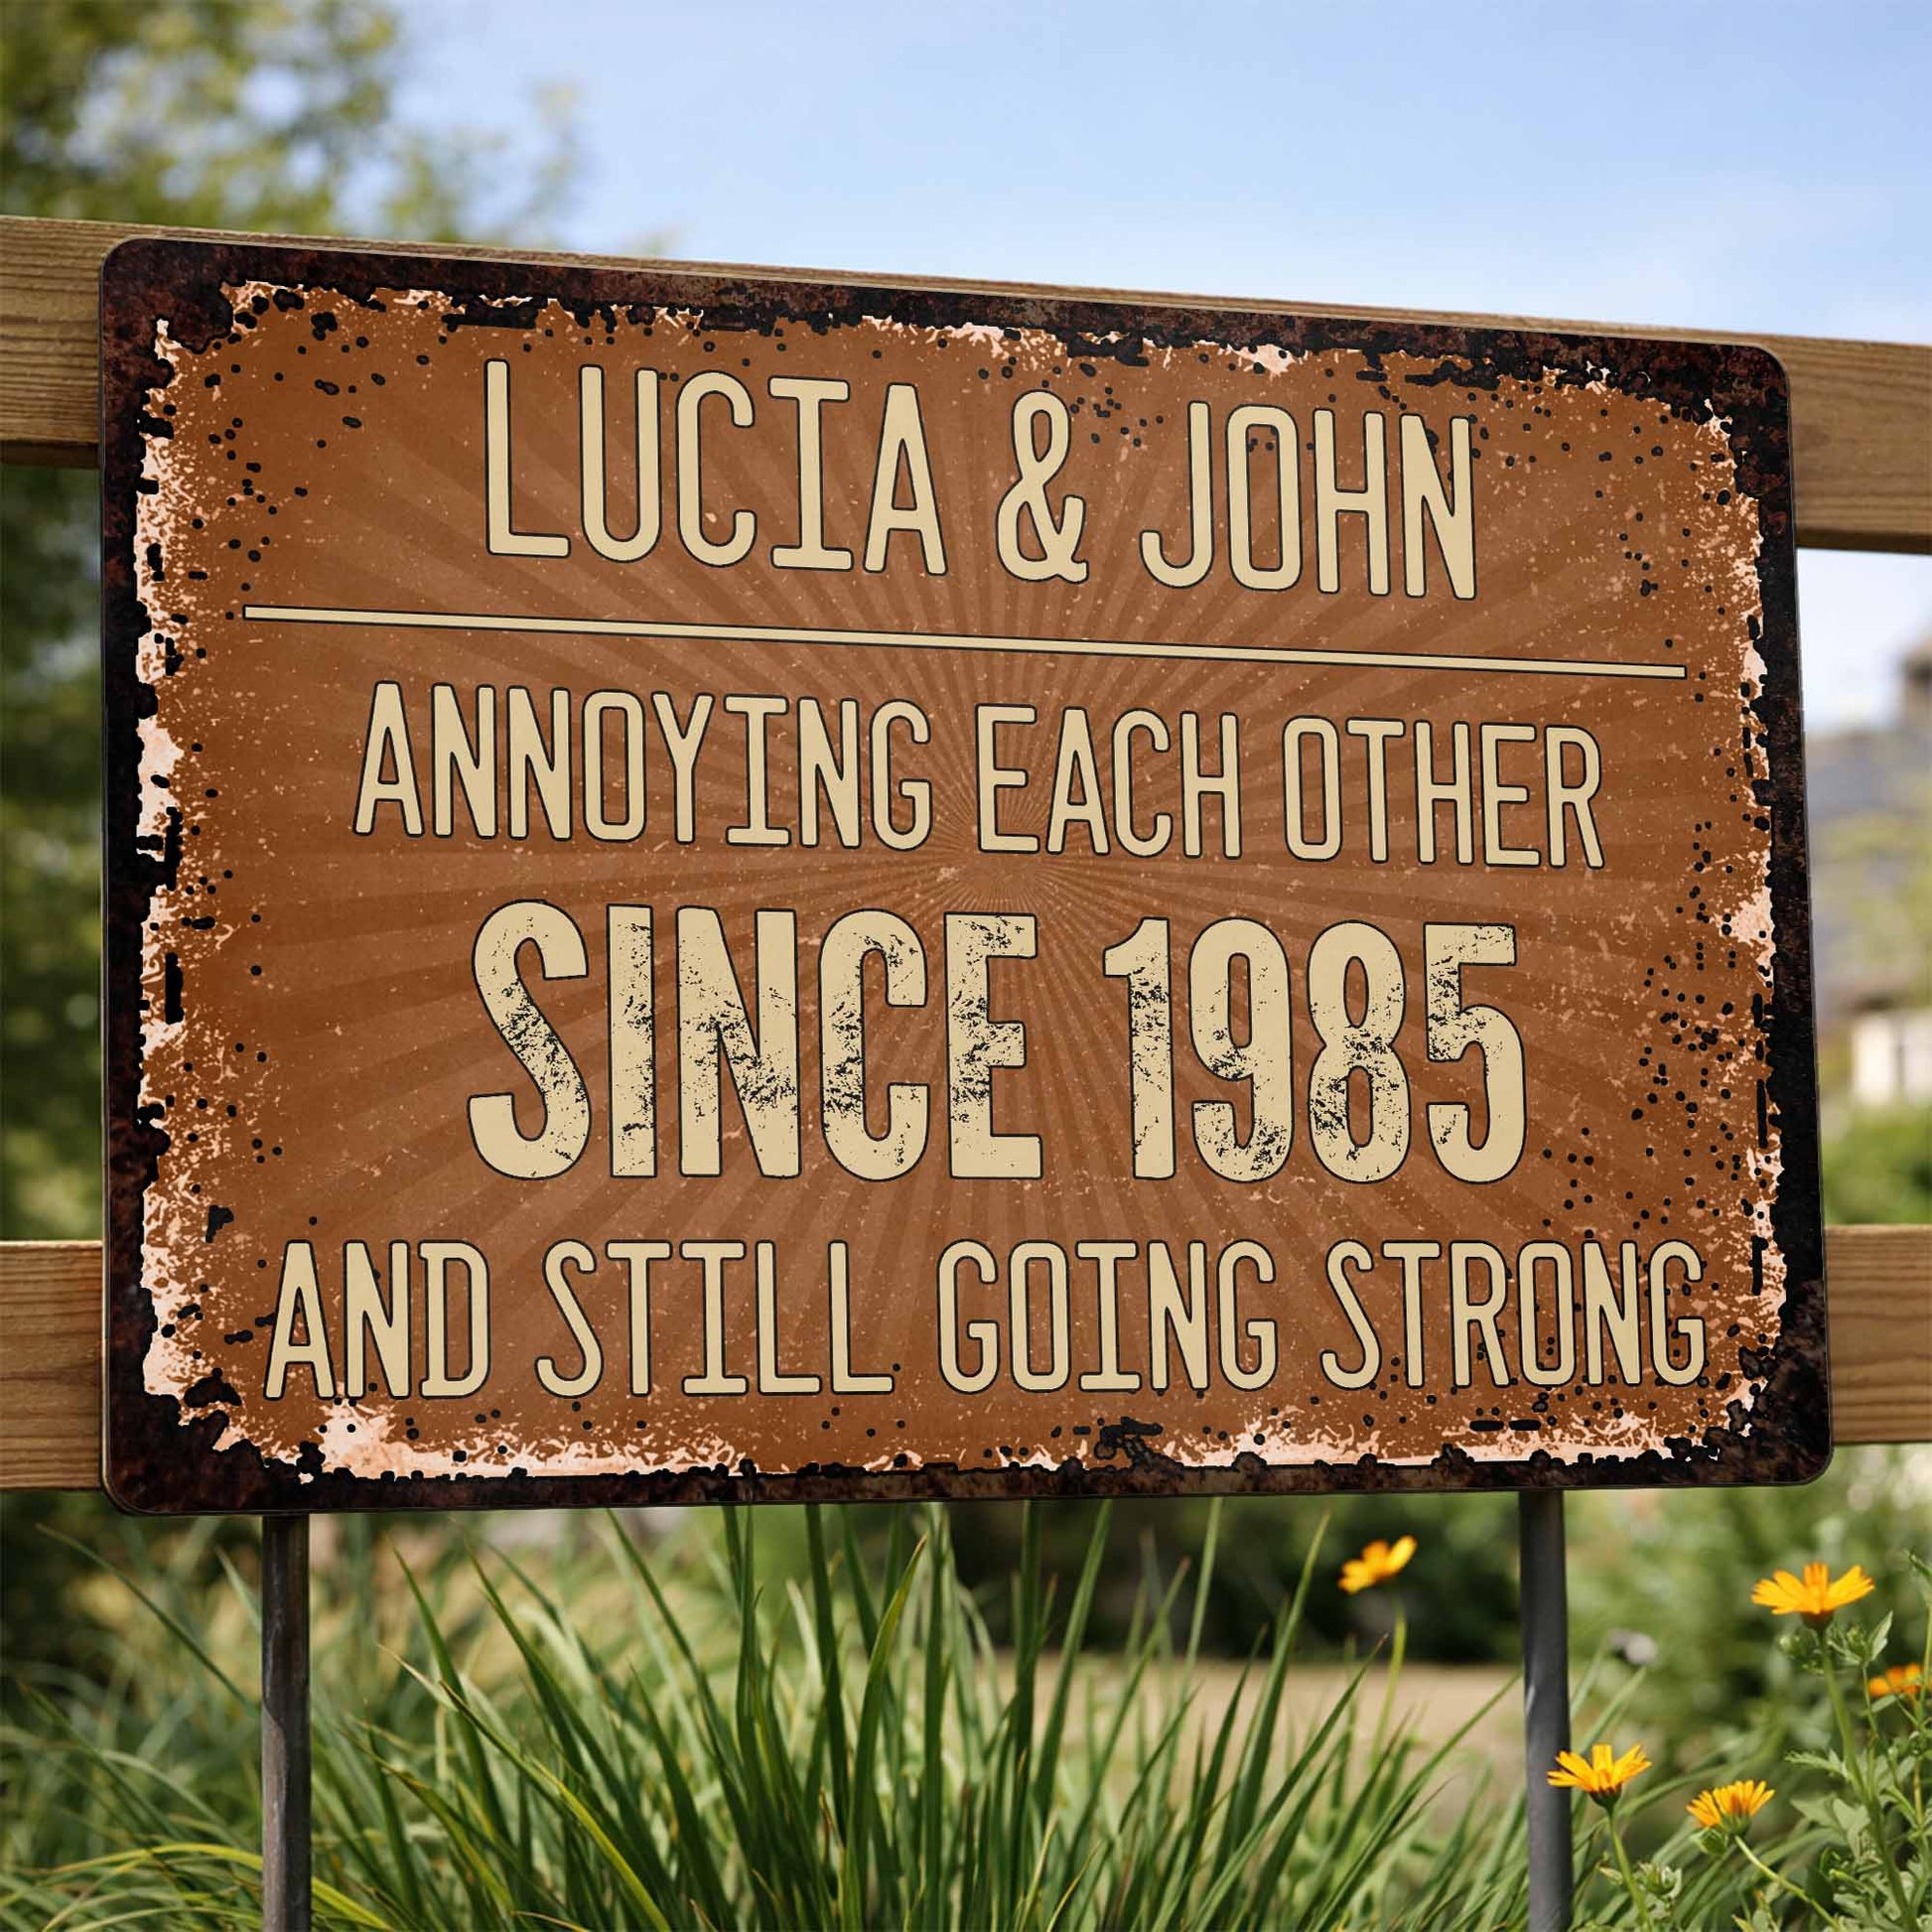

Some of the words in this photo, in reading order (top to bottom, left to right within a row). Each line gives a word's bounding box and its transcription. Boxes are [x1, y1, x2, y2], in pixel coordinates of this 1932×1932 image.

[485, 359, 947, 576] LUCIA
[996, 390, 1089, 584] &
[1141, 401, 1476, 601] JOHN
[353, 681, 931, 851] ANNOYING
[976, 704, 1242, 859] EACH
[1283, 716, 1604, 869] OTHER
[469, 900, 1042, 1181] SINCE
[1103, 917, 1526, 1184] 1985
[264, 1241, 489, 1400] AND
[535, 1239, 895, 1398] STILL
[937, 1239, 1278, 1394] GOING
[1320, 1239, 1706, 1390] STRONG
